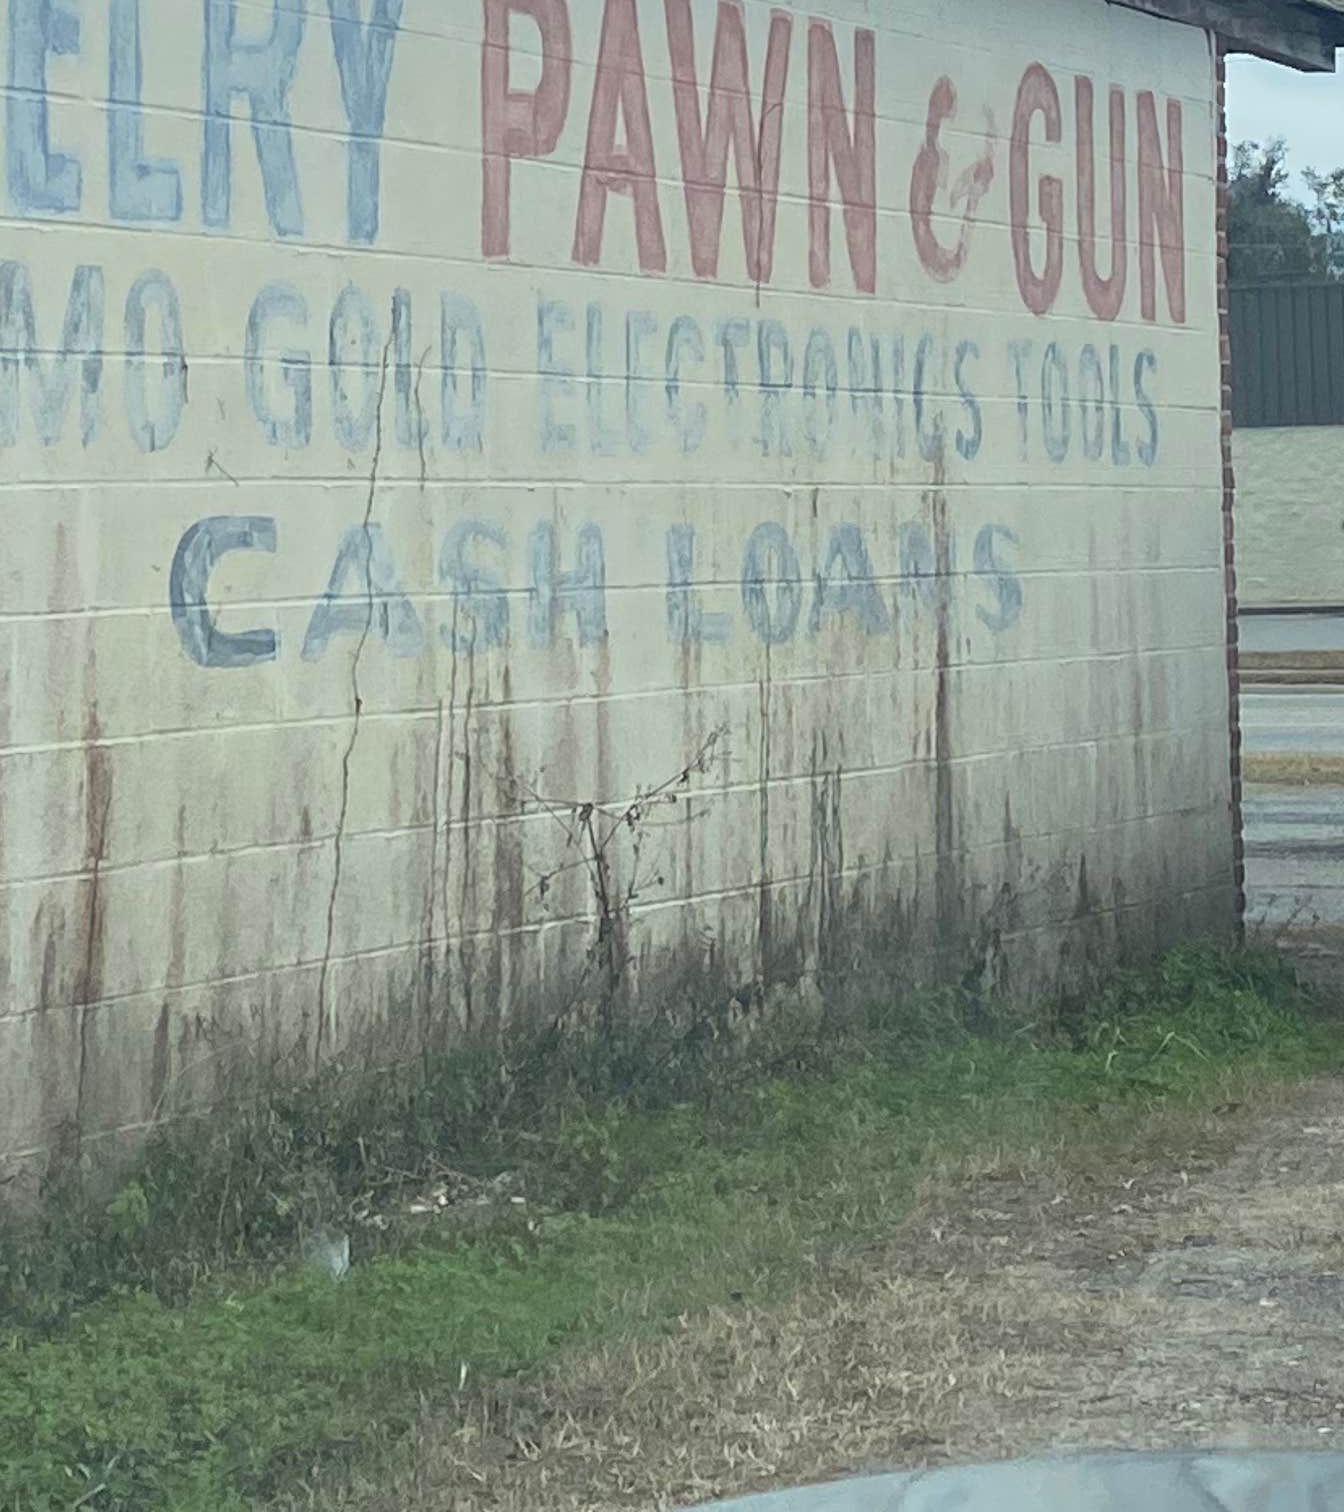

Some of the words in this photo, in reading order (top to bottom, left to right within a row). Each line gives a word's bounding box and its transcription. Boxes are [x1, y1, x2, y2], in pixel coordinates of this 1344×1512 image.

[909, 74, 997, 284] &
[1008, 60, 1186, 325] GUN
[244, 279, 487, 452] GOLD
[536, 299, 983, 462] ELECTRONICS
[1007, 338, 1158, 467] TOOLS
[169, 514, 607, 668] CASH
[664, 520, 1024, 646] LOANS
